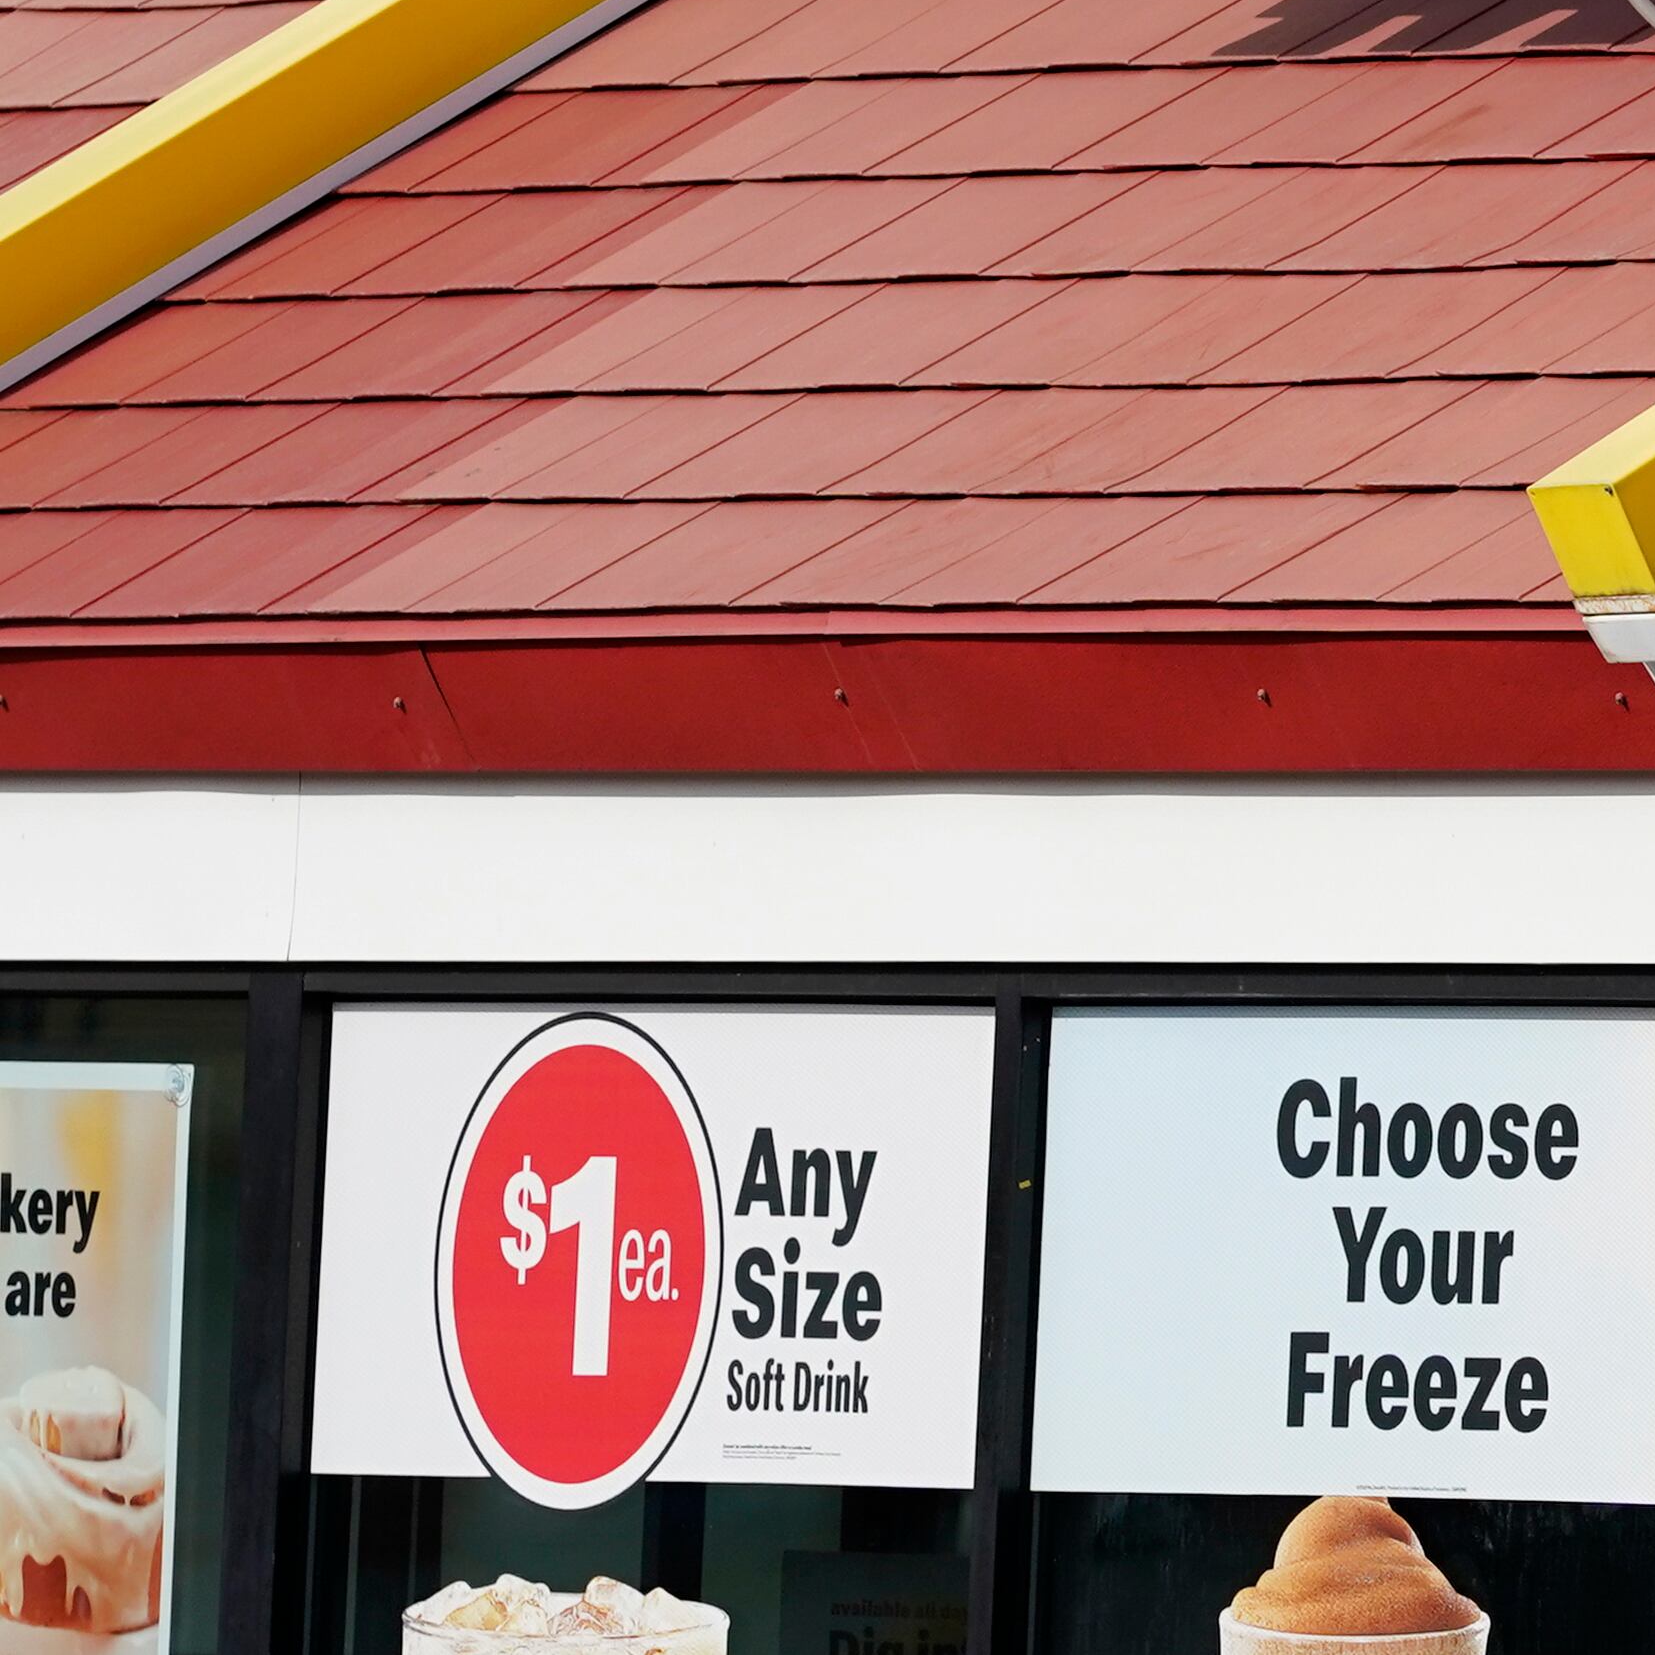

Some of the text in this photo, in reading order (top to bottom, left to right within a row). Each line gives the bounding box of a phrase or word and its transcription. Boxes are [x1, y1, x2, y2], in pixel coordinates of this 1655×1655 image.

[1276, 1076, 1580, 1182] Choose
[733, 1127, 878, 1247] Any
[5, 1270, 77, 1319] are
[500, 1154, 680, 1377] $1 ea.
[731, 1237, 883, 1342] Size
[1332, 1206, 1516, 1306] Your
[726, 1357, 869, 1414] Soft Drink
[1286, 1331, 1550, 1435] Freeze
